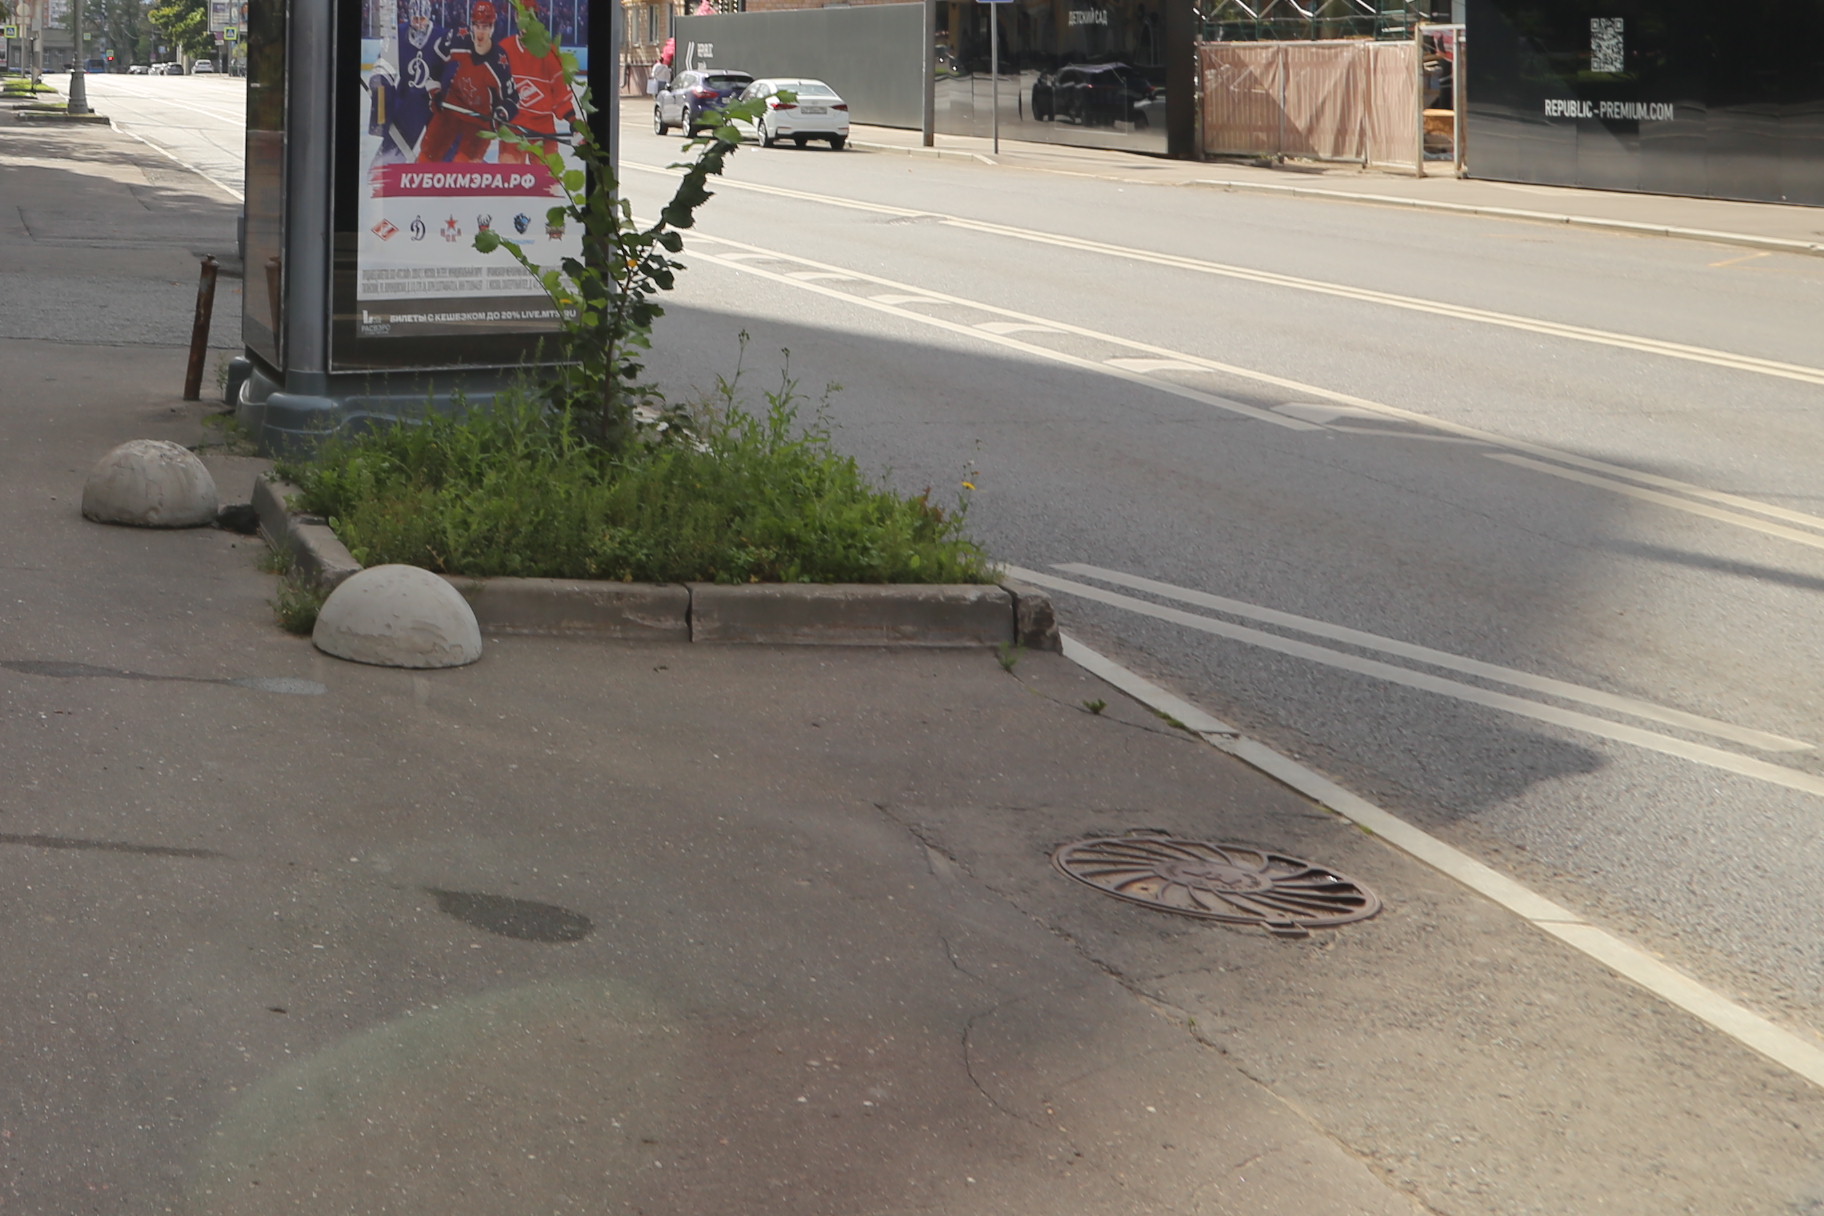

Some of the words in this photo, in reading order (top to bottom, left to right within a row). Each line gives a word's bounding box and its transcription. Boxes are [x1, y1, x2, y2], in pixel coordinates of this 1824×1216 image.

[1068, 7, 1094, 26] ДЕТСКИЙ
[1095, 9, 1108, 26] САД
[400, 173, 536, 189] КУБОКМЭРА.РФ
[389, 314, 426, 323] БИЛЕТЫ
[427, 314, 434, 322] С
[434, 312, 486, 322] КЕШБЭКОМ
[487, 311, 500, 320] ДО
[501, 310, 520, 319] 20%
